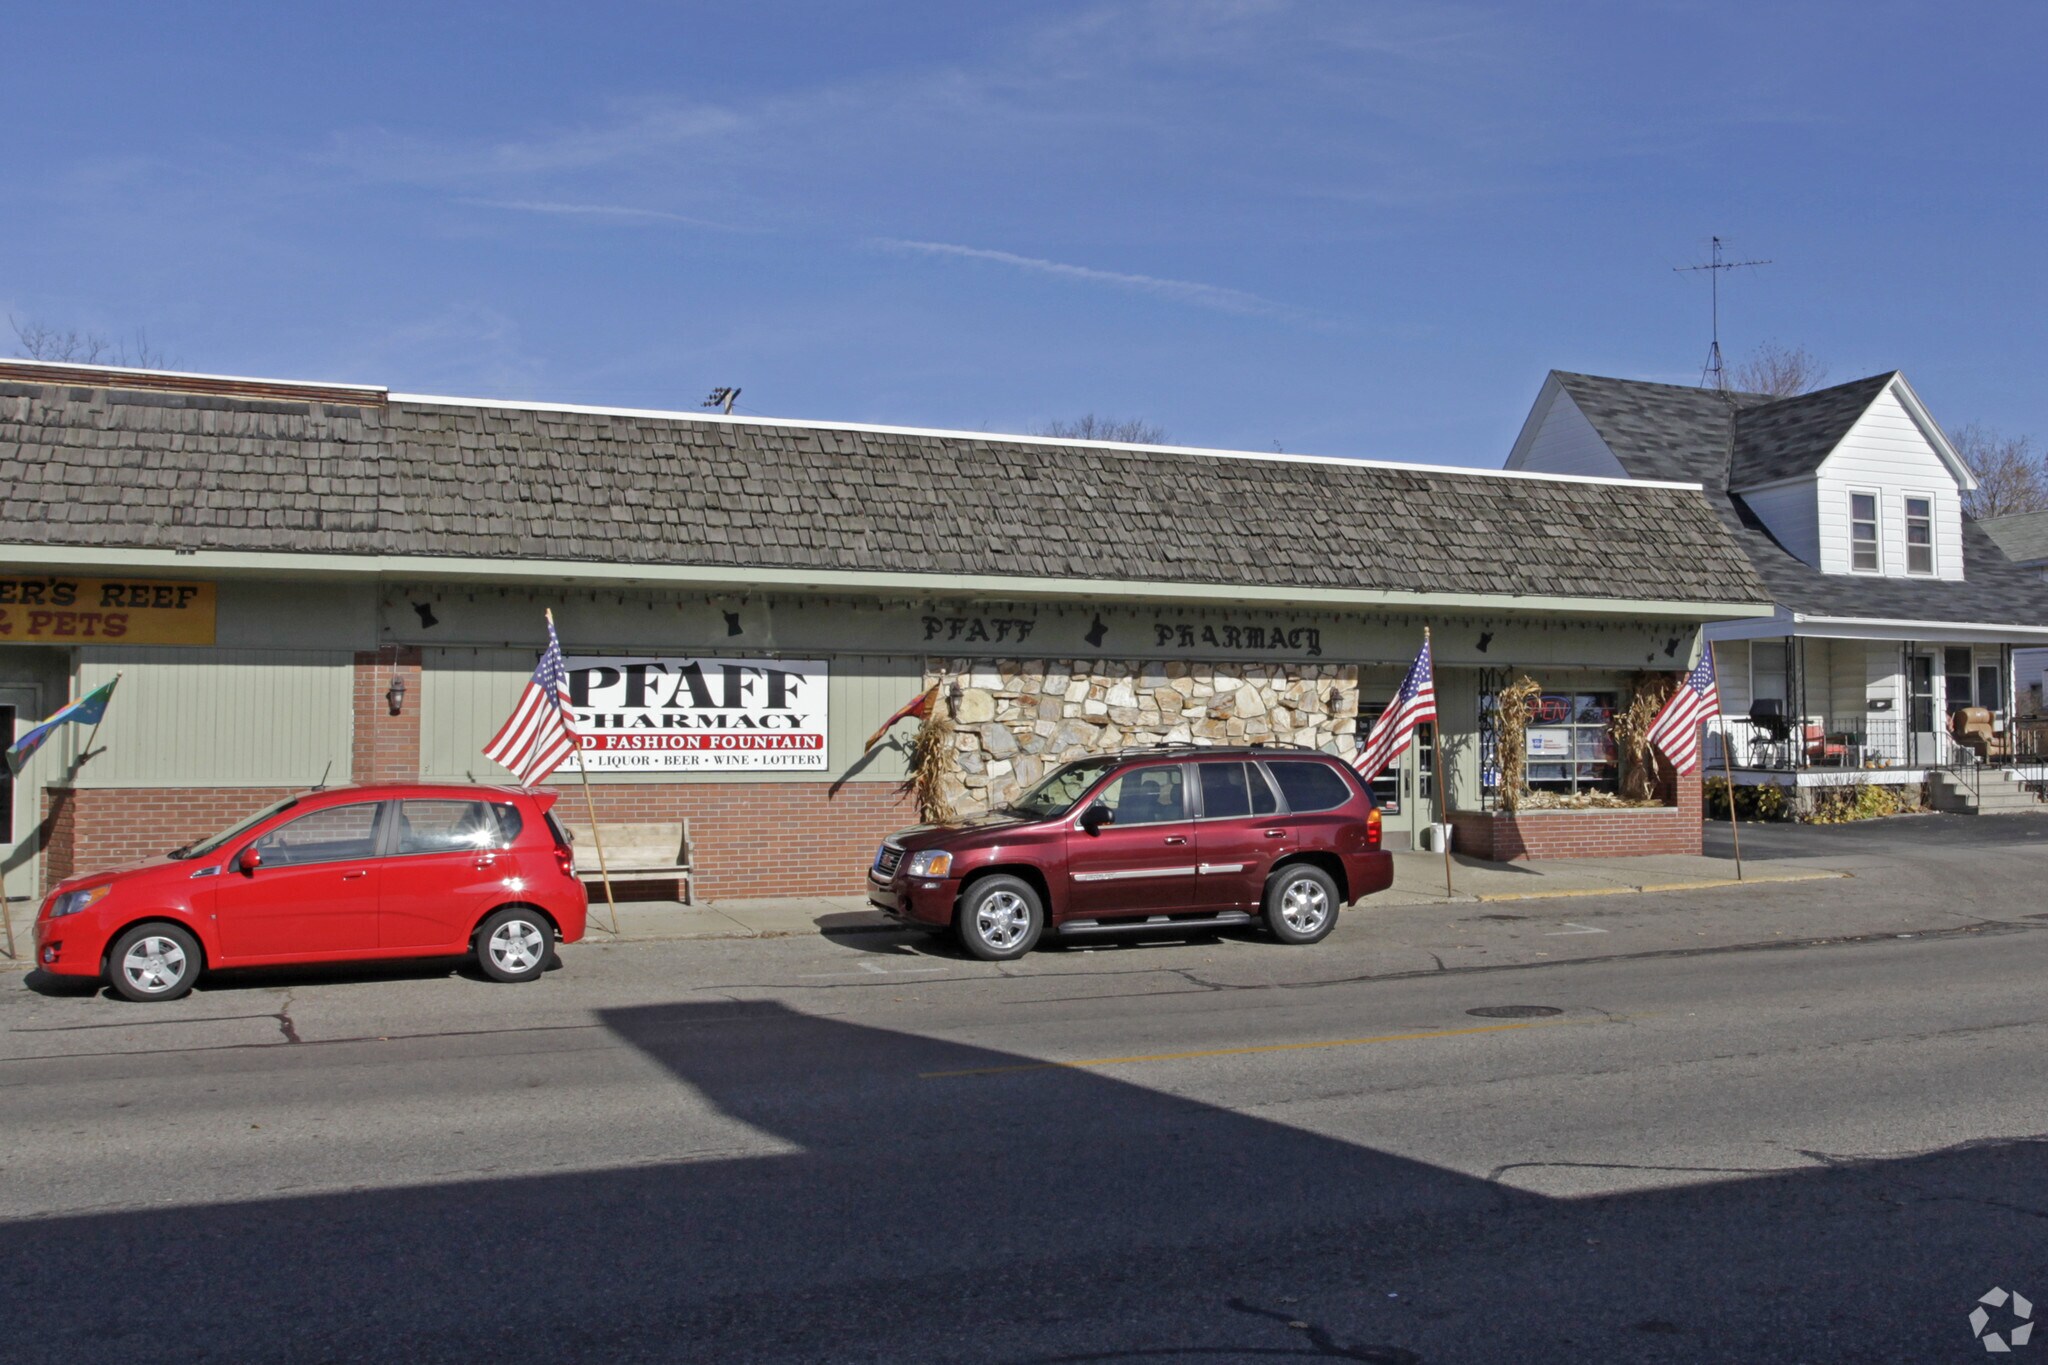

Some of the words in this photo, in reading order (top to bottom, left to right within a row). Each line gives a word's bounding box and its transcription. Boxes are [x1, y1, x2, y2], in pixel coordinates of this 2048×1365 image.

[100, 583, 198, 609] REEF
[27, 611, 129, 637] PETS
[921, 616, 1036, 643] PFAFF
[1154, 623, 1322, 657] PHARMACY
[566, 661, 807, 709] PFAFF
[605, 735, 701, 749] FASHION
[709, 735, 817, 749] FOUNTAIN
[598, 755, 650, 768] LIQUOR
[664, 755, 700, 766] BEER
[713, 755, 750, 765] WINE
[762, 755, 823, 765] LOTTERY
